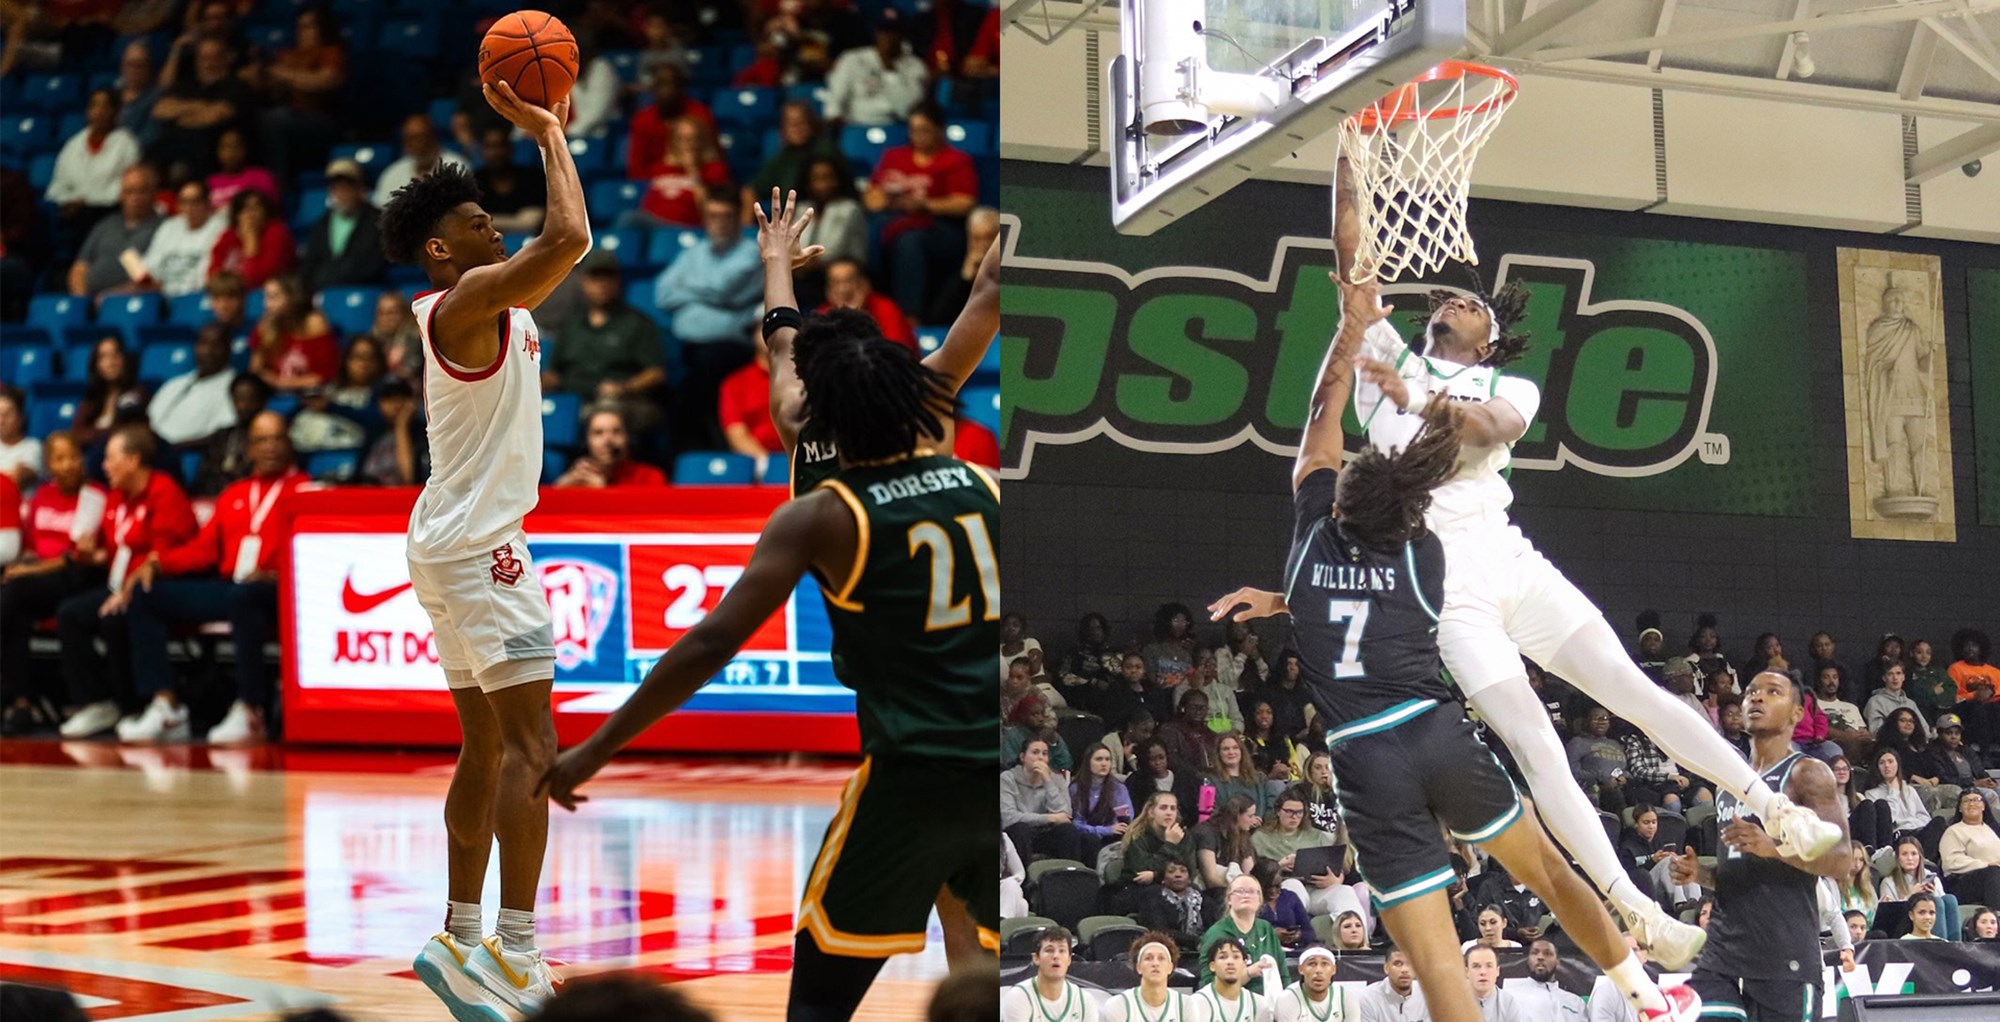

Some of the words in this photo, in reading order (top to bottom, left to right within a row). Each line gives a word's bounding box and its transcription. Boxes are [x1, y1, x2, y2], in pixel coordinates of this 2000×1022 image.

[1704, 441, 1723, 455] TM
[867, 466, 973, 505] DORSEY
[908, 512, 1000, 632] 21
[1311, 563, 1395, 591] WILLIAMS
[662, 564, 745, 629] 27
[334, 630, 392, 663] JUST
[1328, 598, 1370, 679] 7
